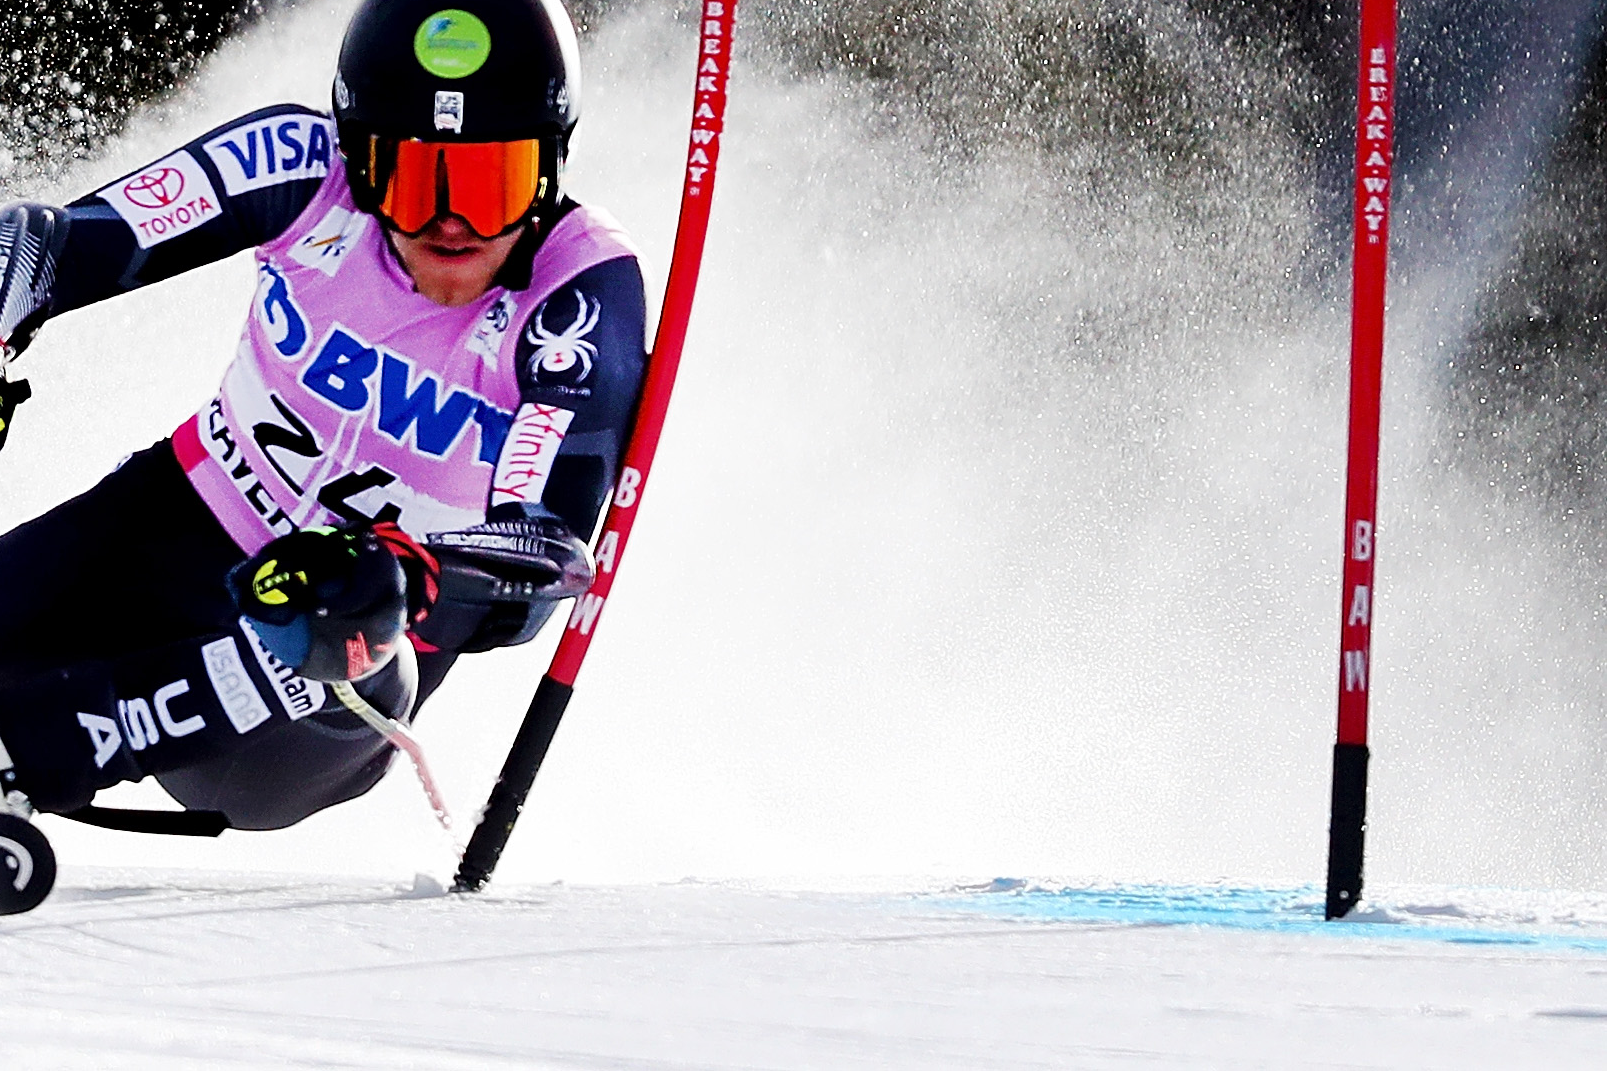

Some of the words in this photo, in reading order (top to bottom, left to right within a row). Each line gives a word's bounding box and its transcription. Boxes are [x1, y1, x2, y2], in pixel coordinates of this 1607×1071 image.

[217, 122, 330, 180] VISA
[139, 196, 213, 238] TOYOTA
[493, 403, 564, 500] xfinity
[76, 679, 206, 769] USA
[210, 642, 259, 724] USANA
